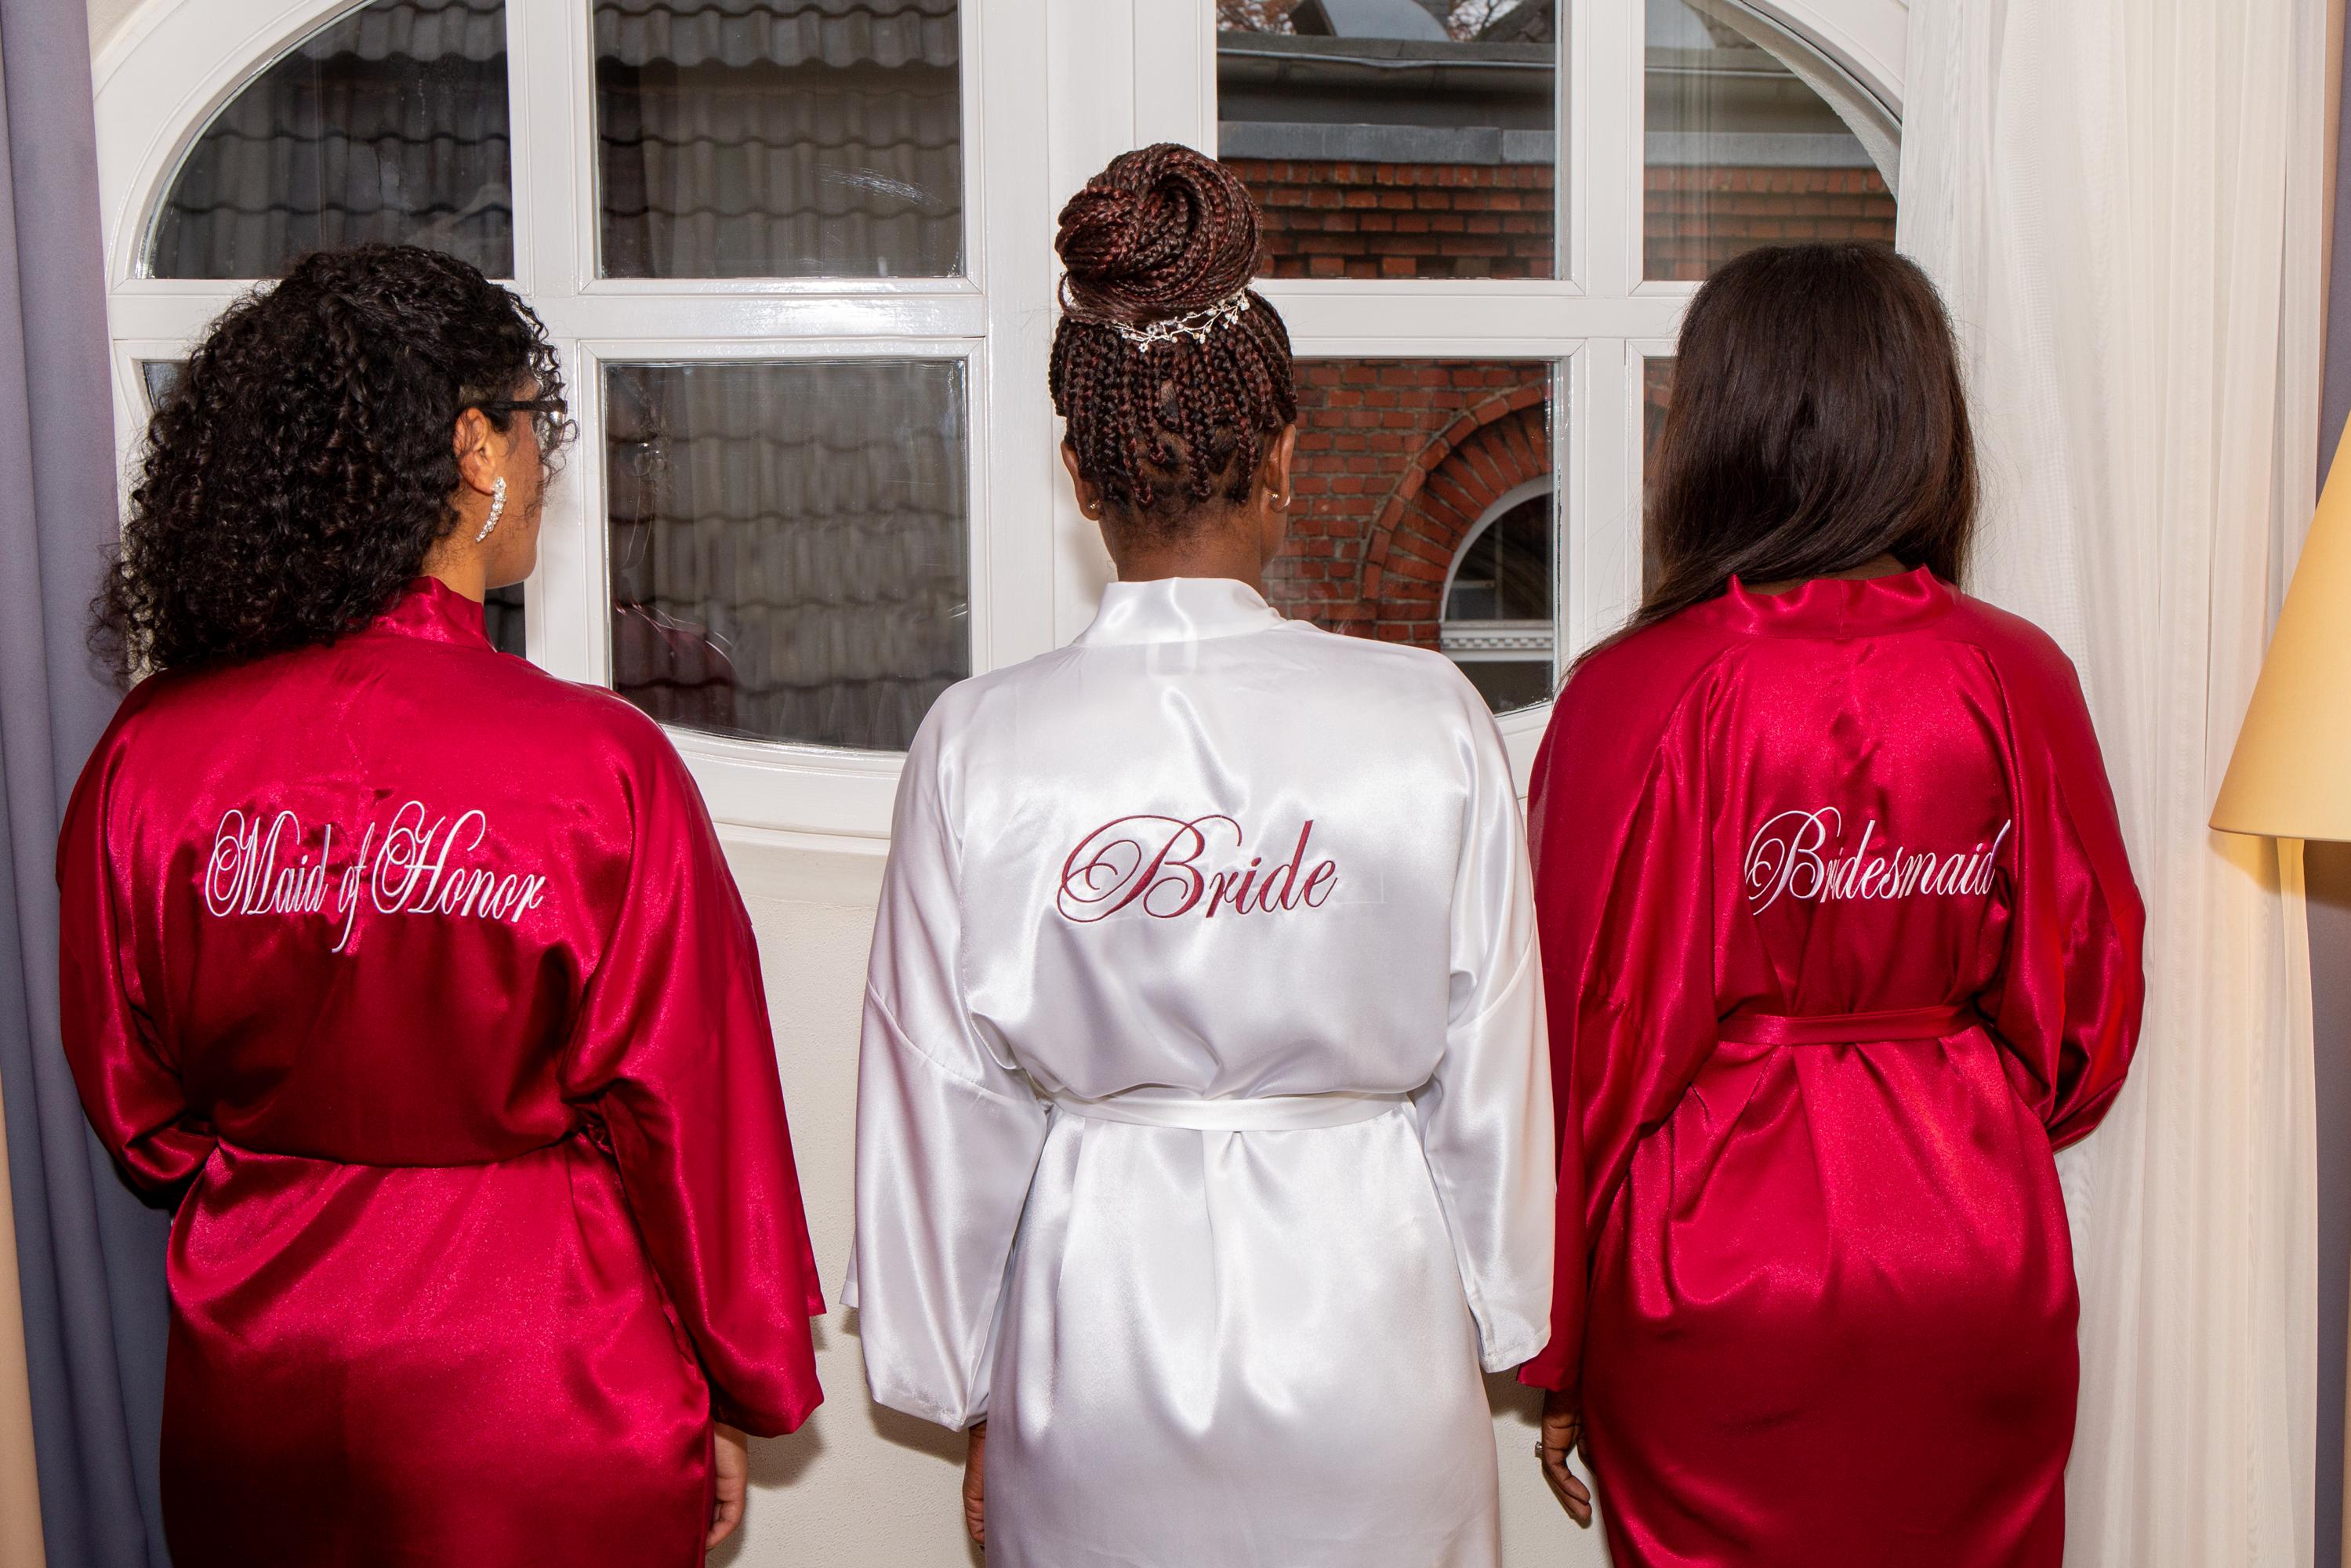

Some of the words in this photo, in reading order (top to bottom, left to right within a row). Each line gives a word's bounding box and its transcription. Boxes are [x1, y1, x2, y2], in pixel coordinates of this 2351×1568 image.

[205, 809, 331, 916] Maid
[332, 822, 376, 953] of
[372, 800, 546, 923] Honor
[1057, 814, 1338, 923] Bride
[1744, 807, 2011, 916] Bridesmaid
